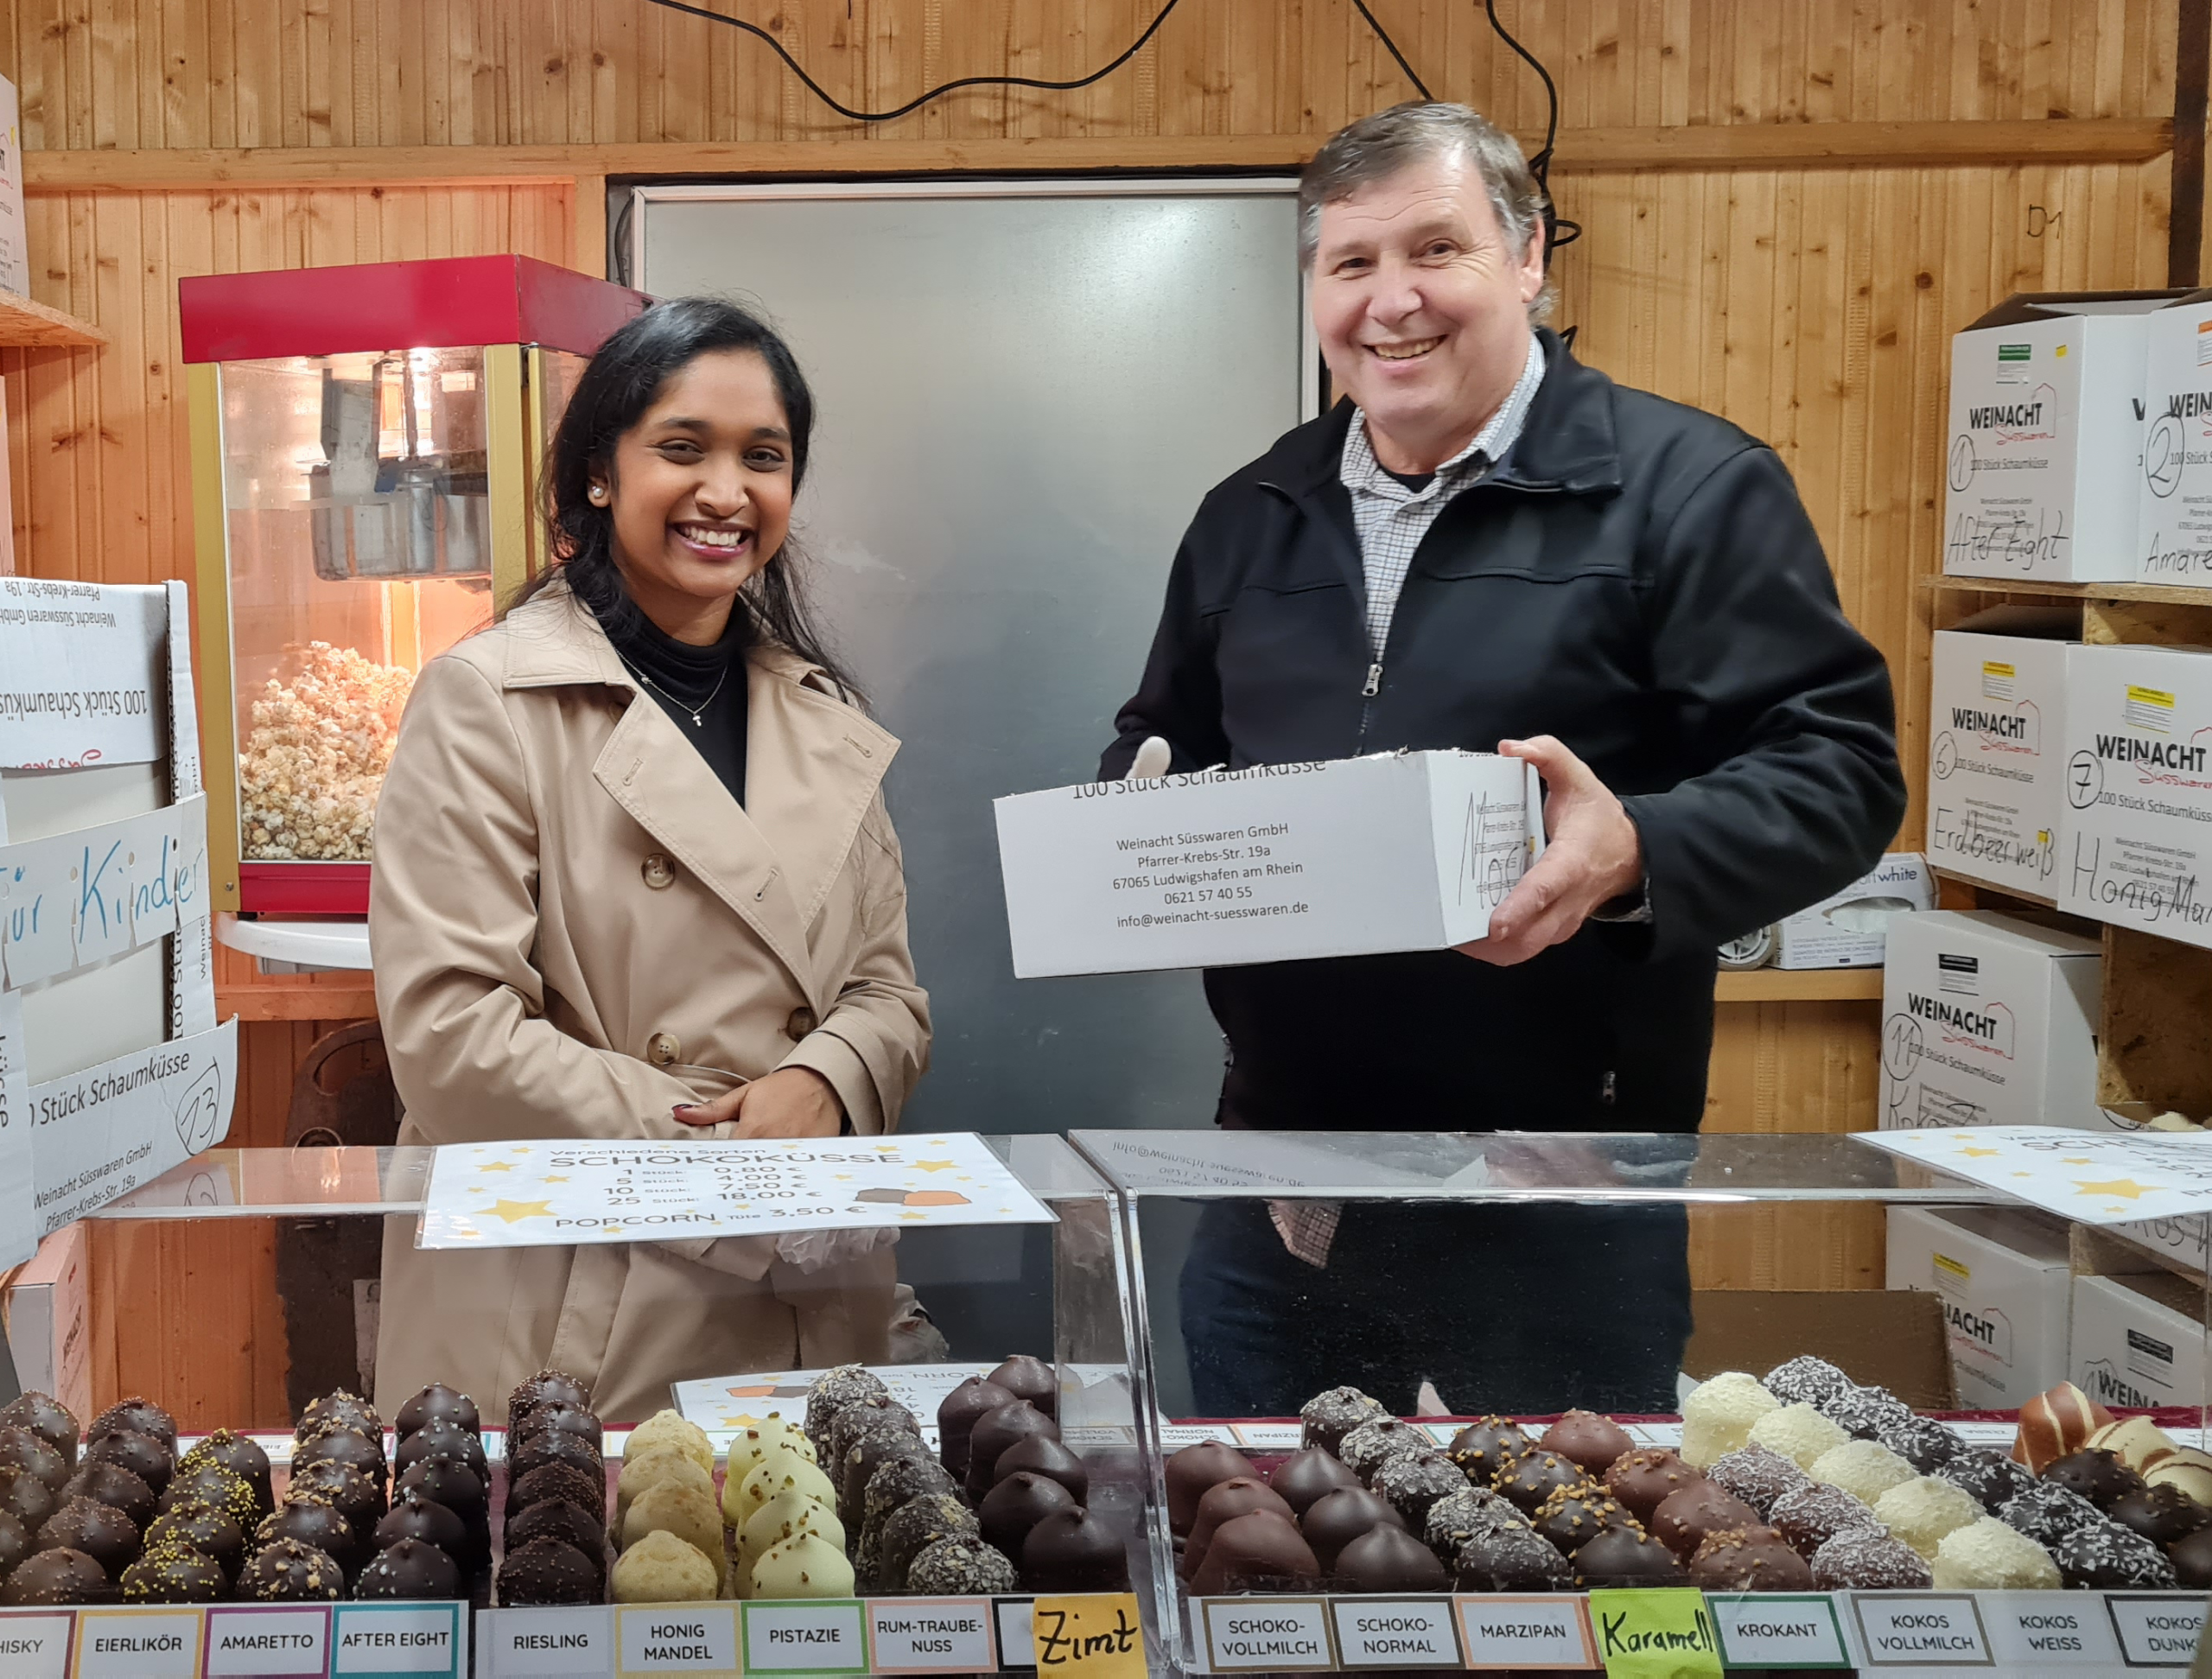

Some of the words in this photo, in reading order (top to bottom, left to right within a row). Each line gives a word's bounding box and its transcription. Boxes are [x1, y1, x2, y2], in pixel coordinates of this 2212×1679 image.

[1970, 403, 2042, 429] WEINACHT
[4, 581, 22, 597] 19a
[24, 582, 100, 601] Pfarrer-Krebs-Str.
[28, 610, 74, 626] Süsswaren
[75, 610, 117, 628] Weinacht
[86, 690, 122, 718] Stück
[124, 690, 147, 715] 100
[1952, 708, 2026, 739] WEINACHT
[2096, 734, 2207, 773] WEINACHT
[2073, 763, 2092, 800] 7
[2098, 791, 2116, 805] 100
[2119, 794, 2145, 811] Stück
[1116, 834, 1174, 851] Weinacht
[1178, 828, 1244, 845] Süsswaren
[1248, 823, 1289, 838] GmbH
[1137, 849, 1244, 868] Pfarrer-Krebs-Str.
[1247, 845, 1271, 858] 19a
[1113, 875, 1150, 890] 67065
[1154, 868, 1238, 887] Ludwigshafen
[1243, 867, 1262, 879] am
[1266, 862, 1303, 876] Rhein
[0, 865, 42, 942] ür
[79, 835, 204, 944] Kinder
[1164, 891, 1195, 905] 0621
[1198, 889, 1213, 901] 57
[1217, 887, 1233, 900] 40
[1236, 886, 1253, 898] 55
[1116, 901, 1309, 928] info@weinacht-suesswaren.de
[1908, 992, 1997, 1040] WEINACHT
[40, 1084, 86, 1126] Stück
[90, 1052, 190, 1106] Schaumküsse
[181, 1086, 217, 1146] 13
[550, 1153, 906, 1167] SCHOKOKÜSSE
[34, 1177, 77, 1210] Weinacht
[79, 1157, 124, 1186] Süsswaren
[125, 1141, 153, 1166] GmbH
[603, 1186, 634, 1195] 10
[719, 1182, 781, 1191] 7.50
[46, 1183, 118, 1232] Pfarrer-Krebs-Str.
[121, 1173, 136, 1193] 19a
[607, 1197, 641, 1205] 25
[716, 1191, 796, 1200] 18.00
[556, 1213, 716, 1228] POPCORN
[769, 1206, 835, 1218] 3.50
[877, 1618, 983, 1634] RUM-TRAUBE-
[1229, 1619, 1306, 1634] SCHOKO-
[1357, 1618, 1434, 1632] SCHOKO-
[1736, 1623, 1817, 1638] KROKANT
[1890, 1614, 1950, 1630] KOKOS
[2018, 1614, 2078, 1630] KOKOS
[2145, 1616, 2203, 1631] KOKOS
[342, 1632, 398, 1648] AFTER
[400, 1631, 449, 1647] EIGHT
[651, 1624, 705, 1639] HONIG
[770, 1627, 841, 1644] PISTAZIE
[1036, 1608, 1138, 1665] Zimt
[1480, 1624, 1567, 1639] MARZIPAN
[1602, 1607, 1716, 1657] Karamell
[95, 1634, 183, 1653] EIERLIKÖR
[220, 1634, 314, 1650] AMARETTO
[513, 1633, 588, 1650] RIESLING
[912, 1638, 953, 1654] NUSS
[1222, 1639, 1319, 1657] VOLLMILCH
[1363, 1638, 1437, 1654] NORMAL
[1877, 1637, 1975, 1650] VOLLMILCH
[2029, 1637, 2082, 1651] WEISS
[644, 1644, 713, 1661] MANDEL
